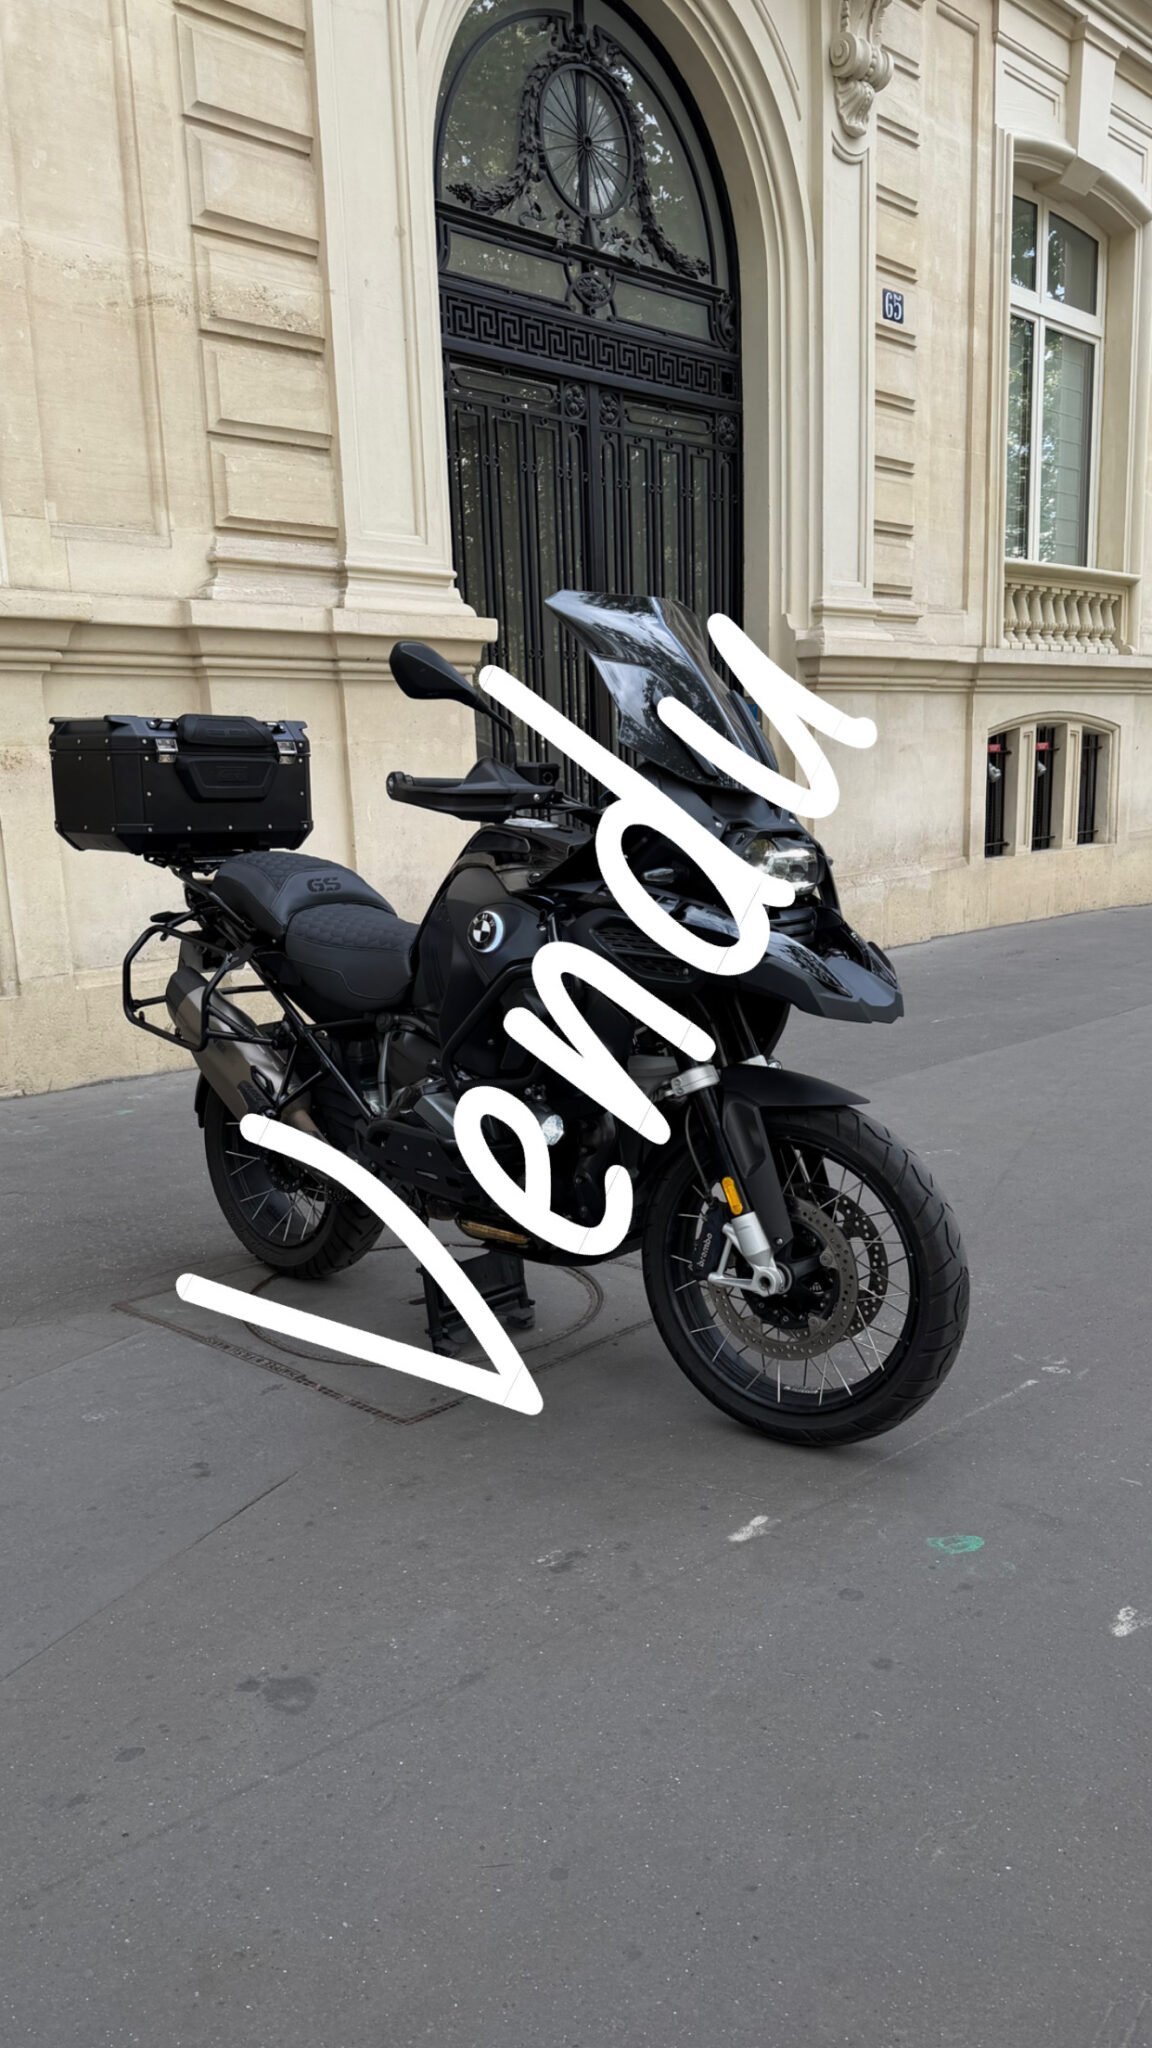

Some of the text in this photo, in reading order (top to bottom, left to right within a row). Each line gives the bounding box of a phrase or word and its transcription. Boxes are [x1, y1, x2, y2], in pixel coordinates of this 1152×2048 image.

[885, 291, 902, 321] 65
[307, 877, 342, 892] GS
[696, 1232, 713, 1268] brembo
